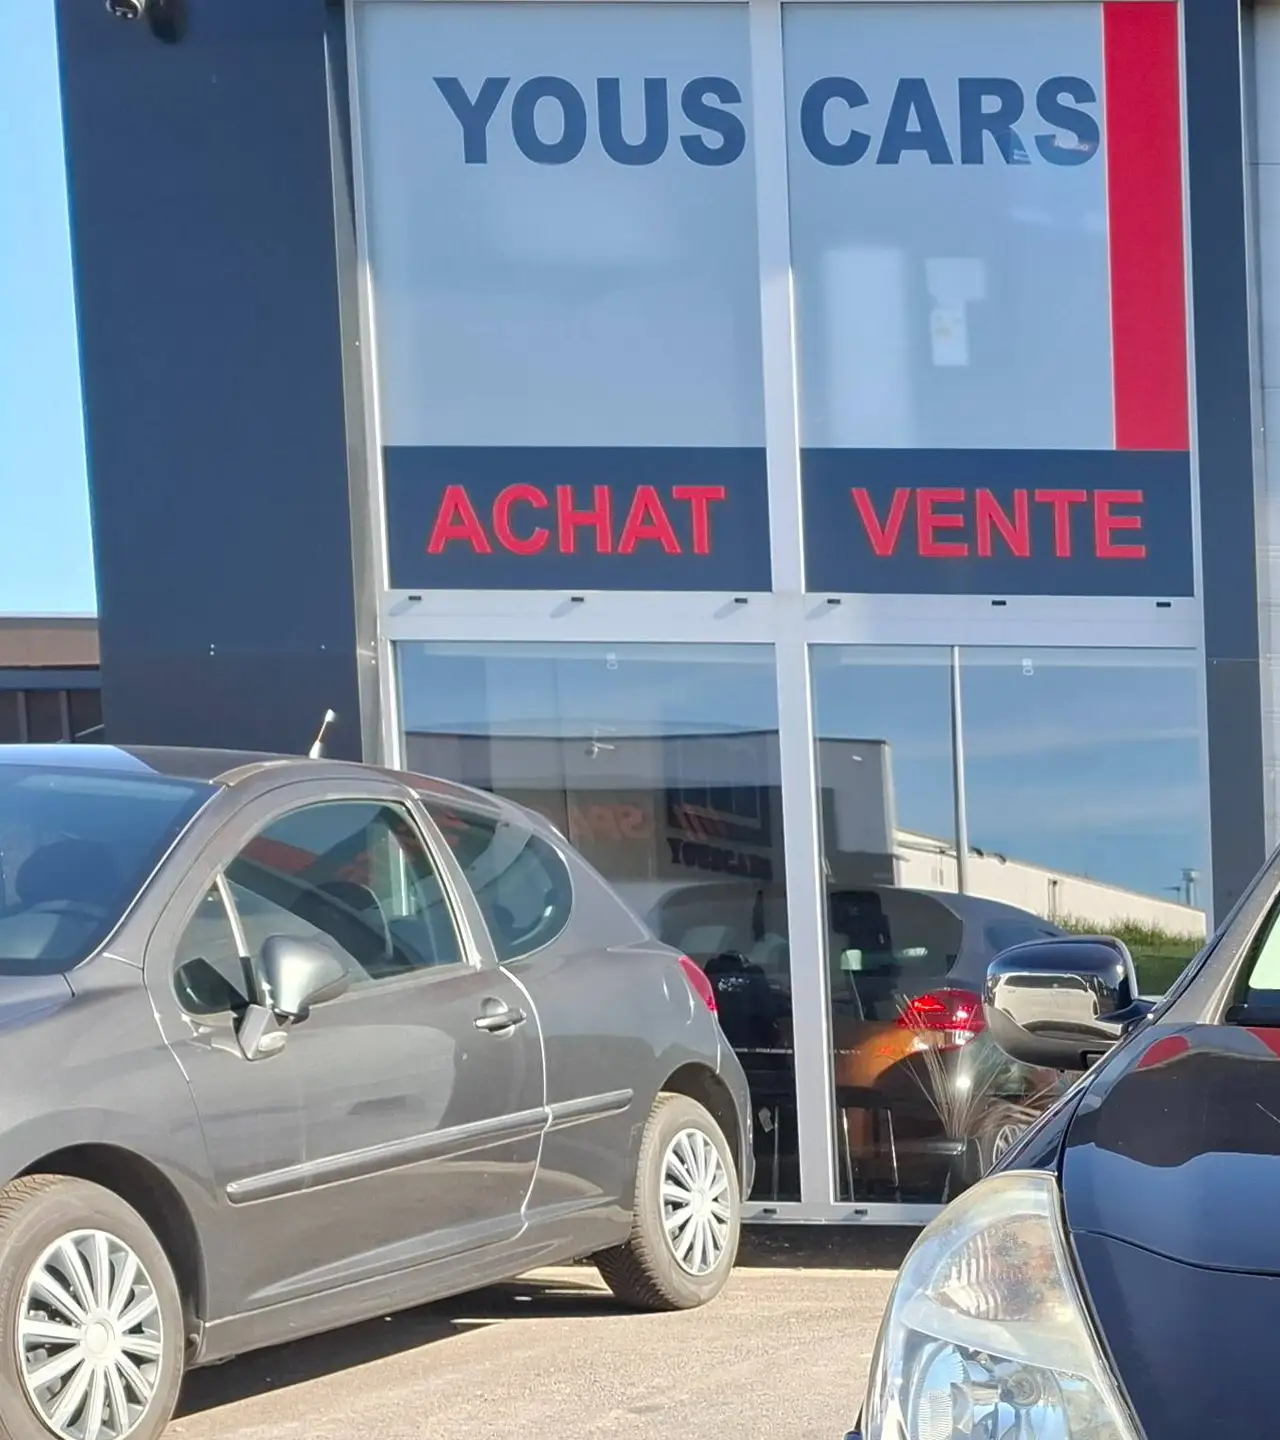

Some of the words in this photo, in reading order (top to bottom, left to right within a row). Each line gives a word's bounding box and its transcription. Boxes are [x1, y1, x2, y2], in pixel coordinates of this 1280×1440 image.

[434, 76, 746, 167] YOUS
[800, 76, 1101, 167] CARS
[426, 482, 726, 555] ACHAT
[850, 486, 1147, 559] VENTE
